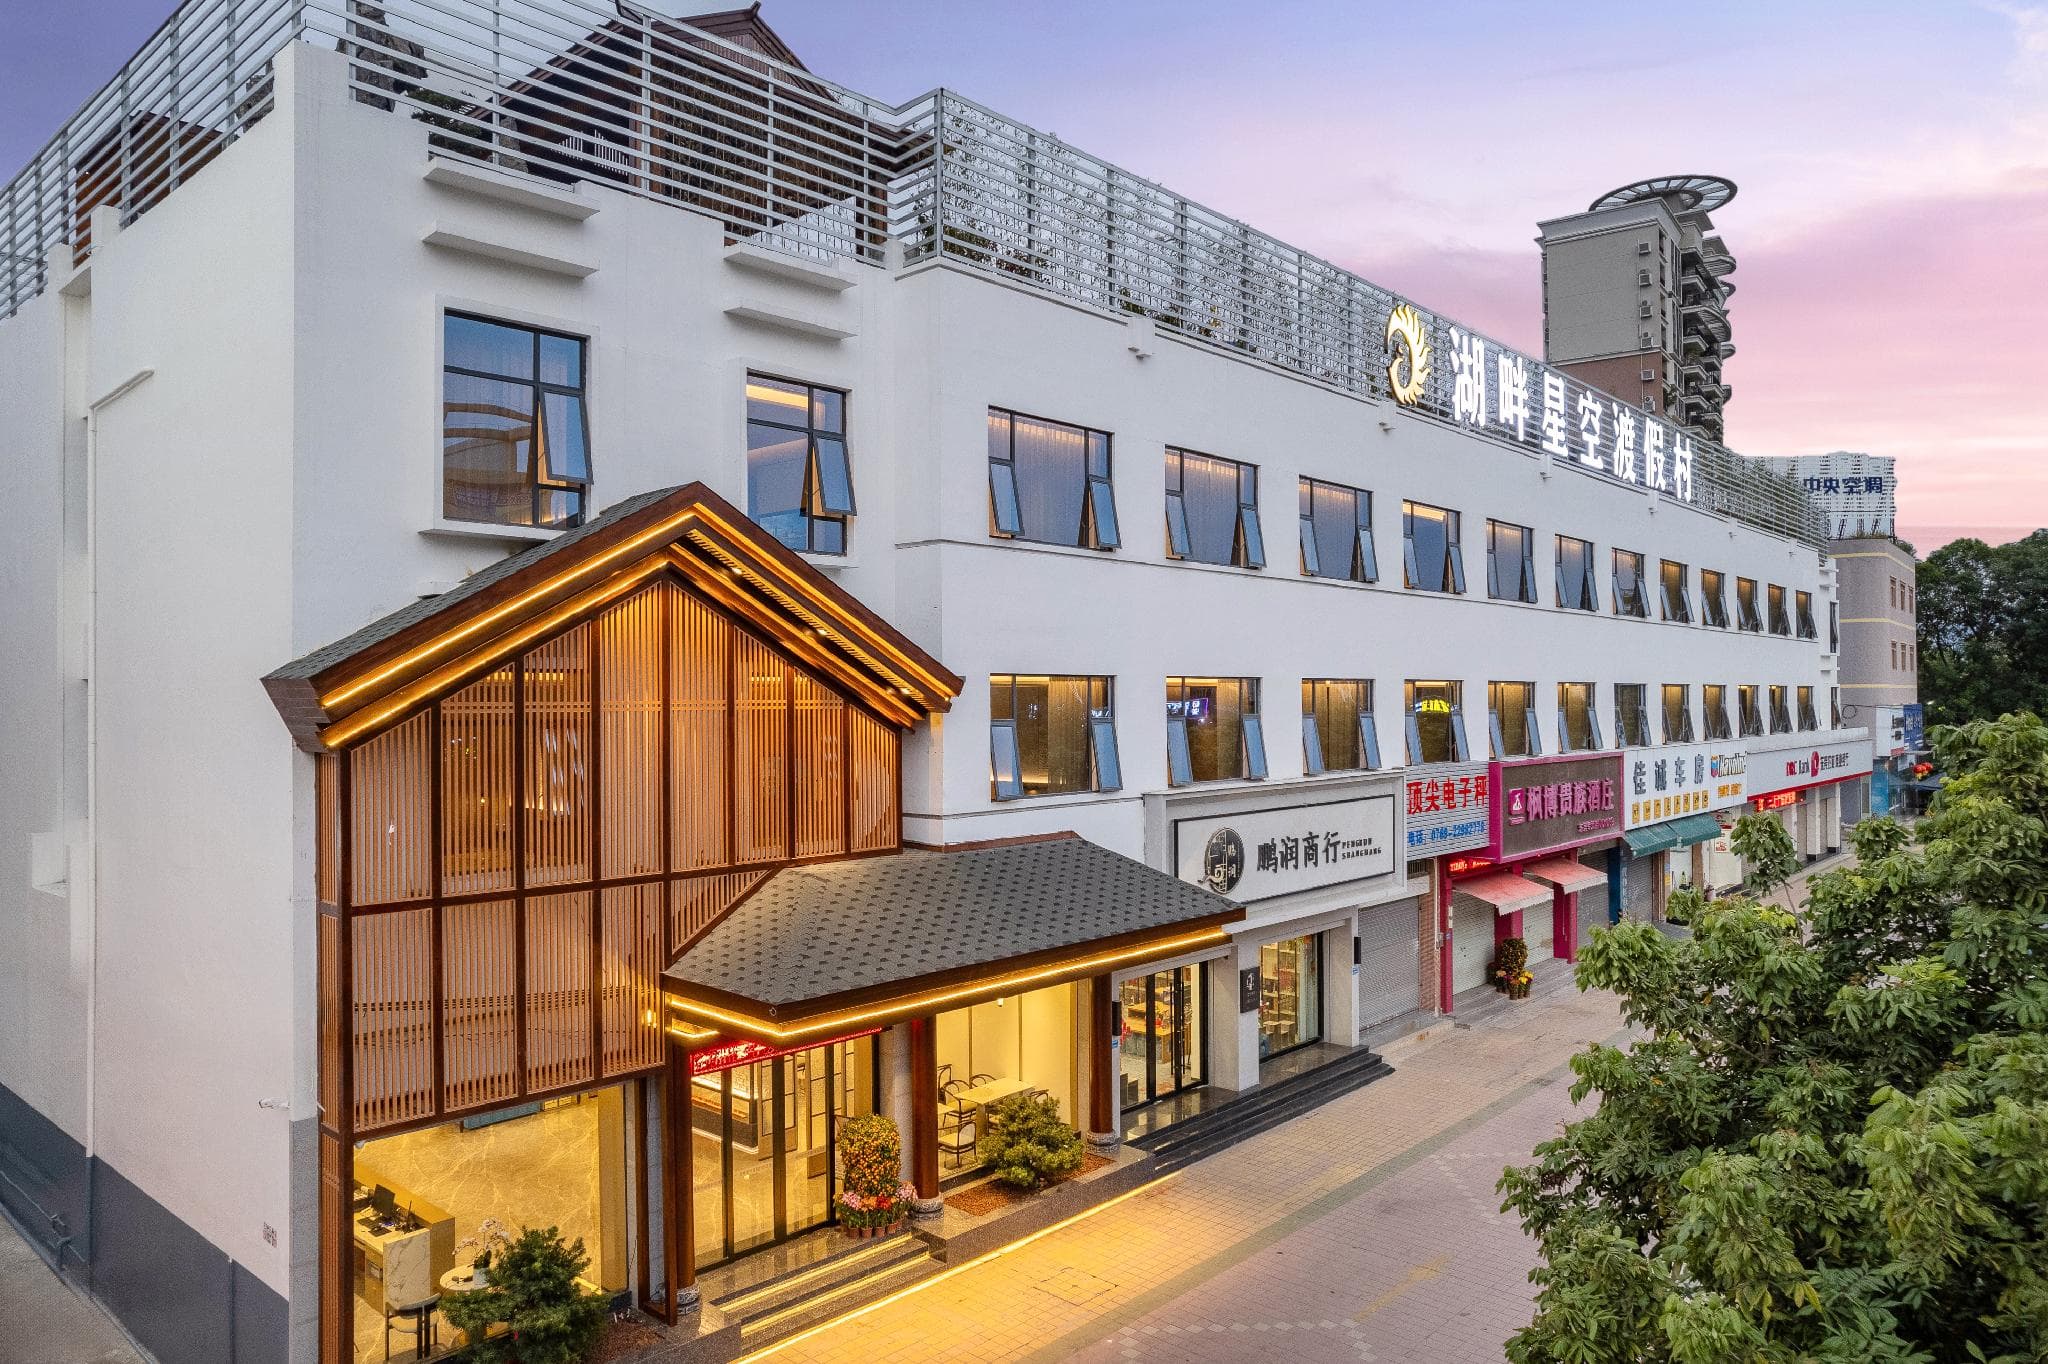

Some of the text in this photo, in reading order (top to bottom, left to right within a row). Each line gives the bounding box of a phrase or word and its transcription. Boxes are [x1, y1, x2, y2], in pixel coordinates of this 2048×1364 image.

[1450, 326, 1693, 502] 湖畔星空渡假村
[1407, 775, 1488, 815] 顶尖电子秤
[1256, 831, 1341, 873] 鹏润商行
